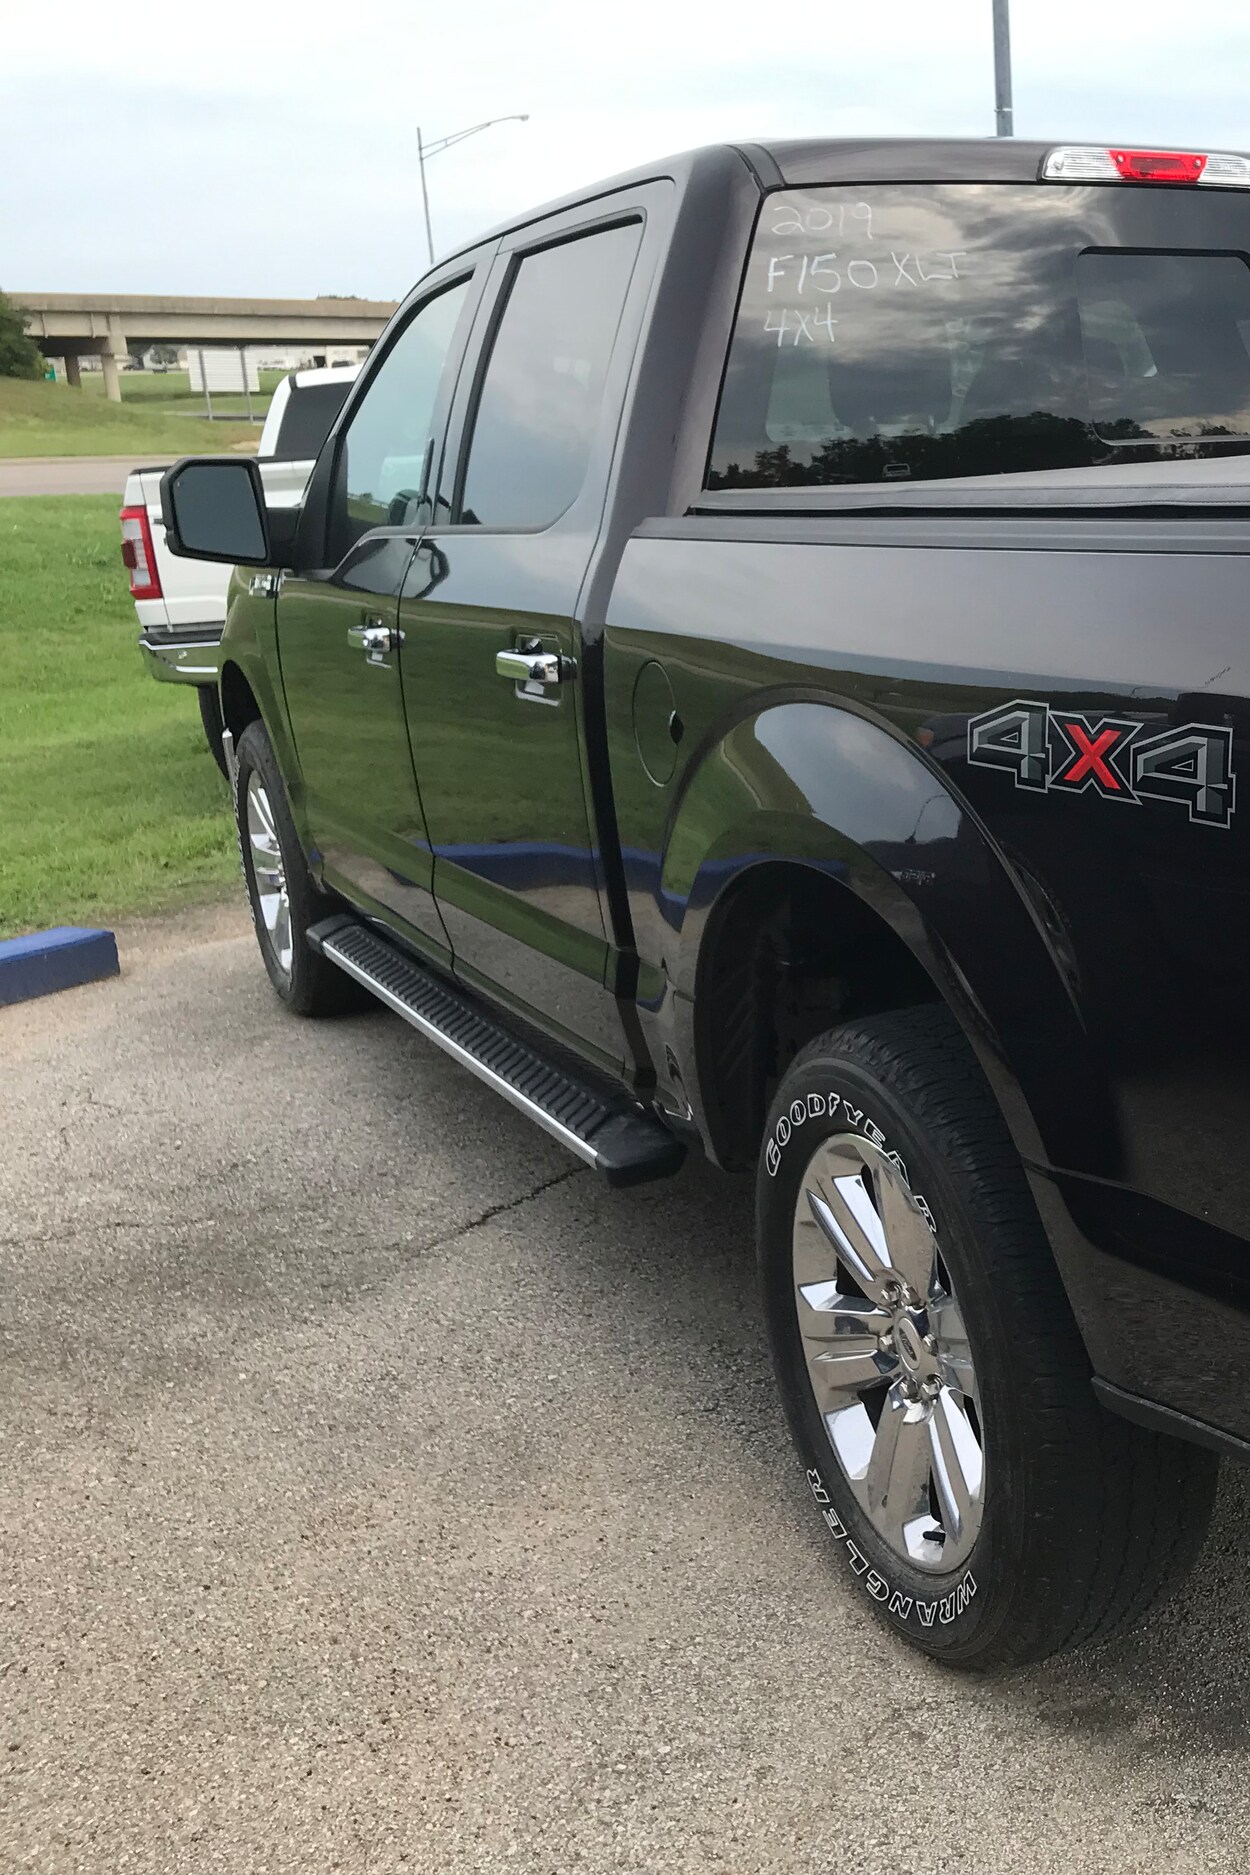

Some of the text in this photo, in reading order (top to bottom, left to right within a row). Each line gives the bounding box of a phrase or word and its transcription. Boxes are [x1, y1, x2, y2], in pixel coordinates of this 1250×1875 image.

[771, 202, 873, 240] 2019
[767, 251, 967, 294] F150 XLT
[806, 1468, 978, 1627] WRANGLER
